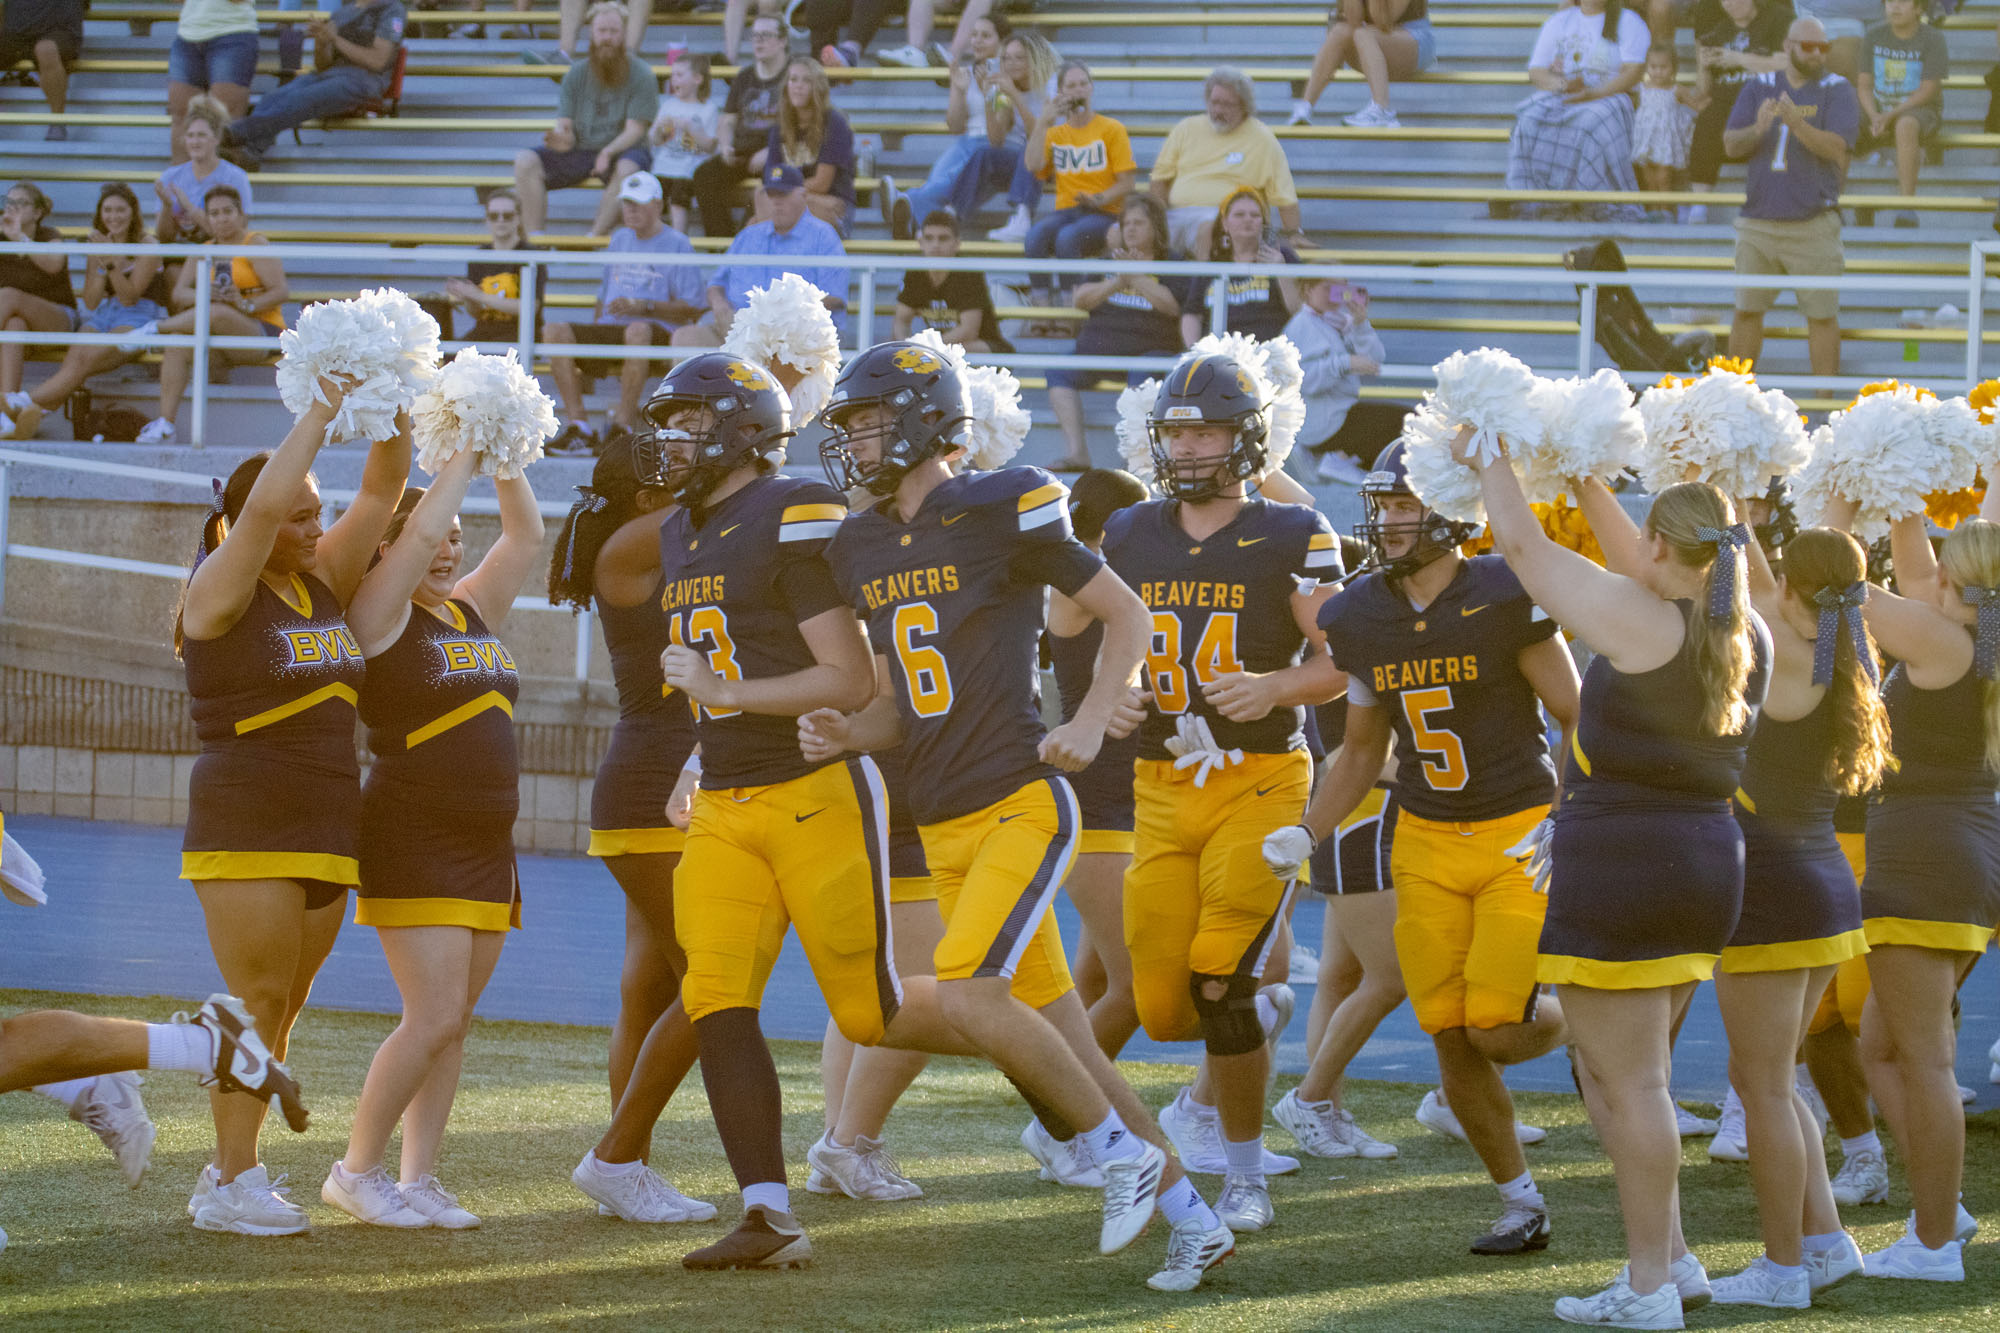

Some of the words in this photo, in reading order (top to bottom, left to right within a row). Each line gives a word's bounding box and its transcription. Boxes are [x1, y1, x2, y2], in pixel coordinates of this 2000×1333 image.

[1873, 45, 1921, 60] MONDAY
[1053, 143, 1103, 168] BVU
[1771, 123, 1788, 171] 1
[661, 575, 725, 612] BEAVERS
[862, 565, 960, 610] BEAVERS
[1141, 581, 1246, 609] BEAVERS
[281, 624, 364, 668] BVU
[433, 639, 518, 676] BVU
[892, 601, 954, 718] 6
[1145, 611, 1245, 715] 84
[1372, 655, 1479, 692] BEAVERS
[1400, 686, 1470, 791] 5
